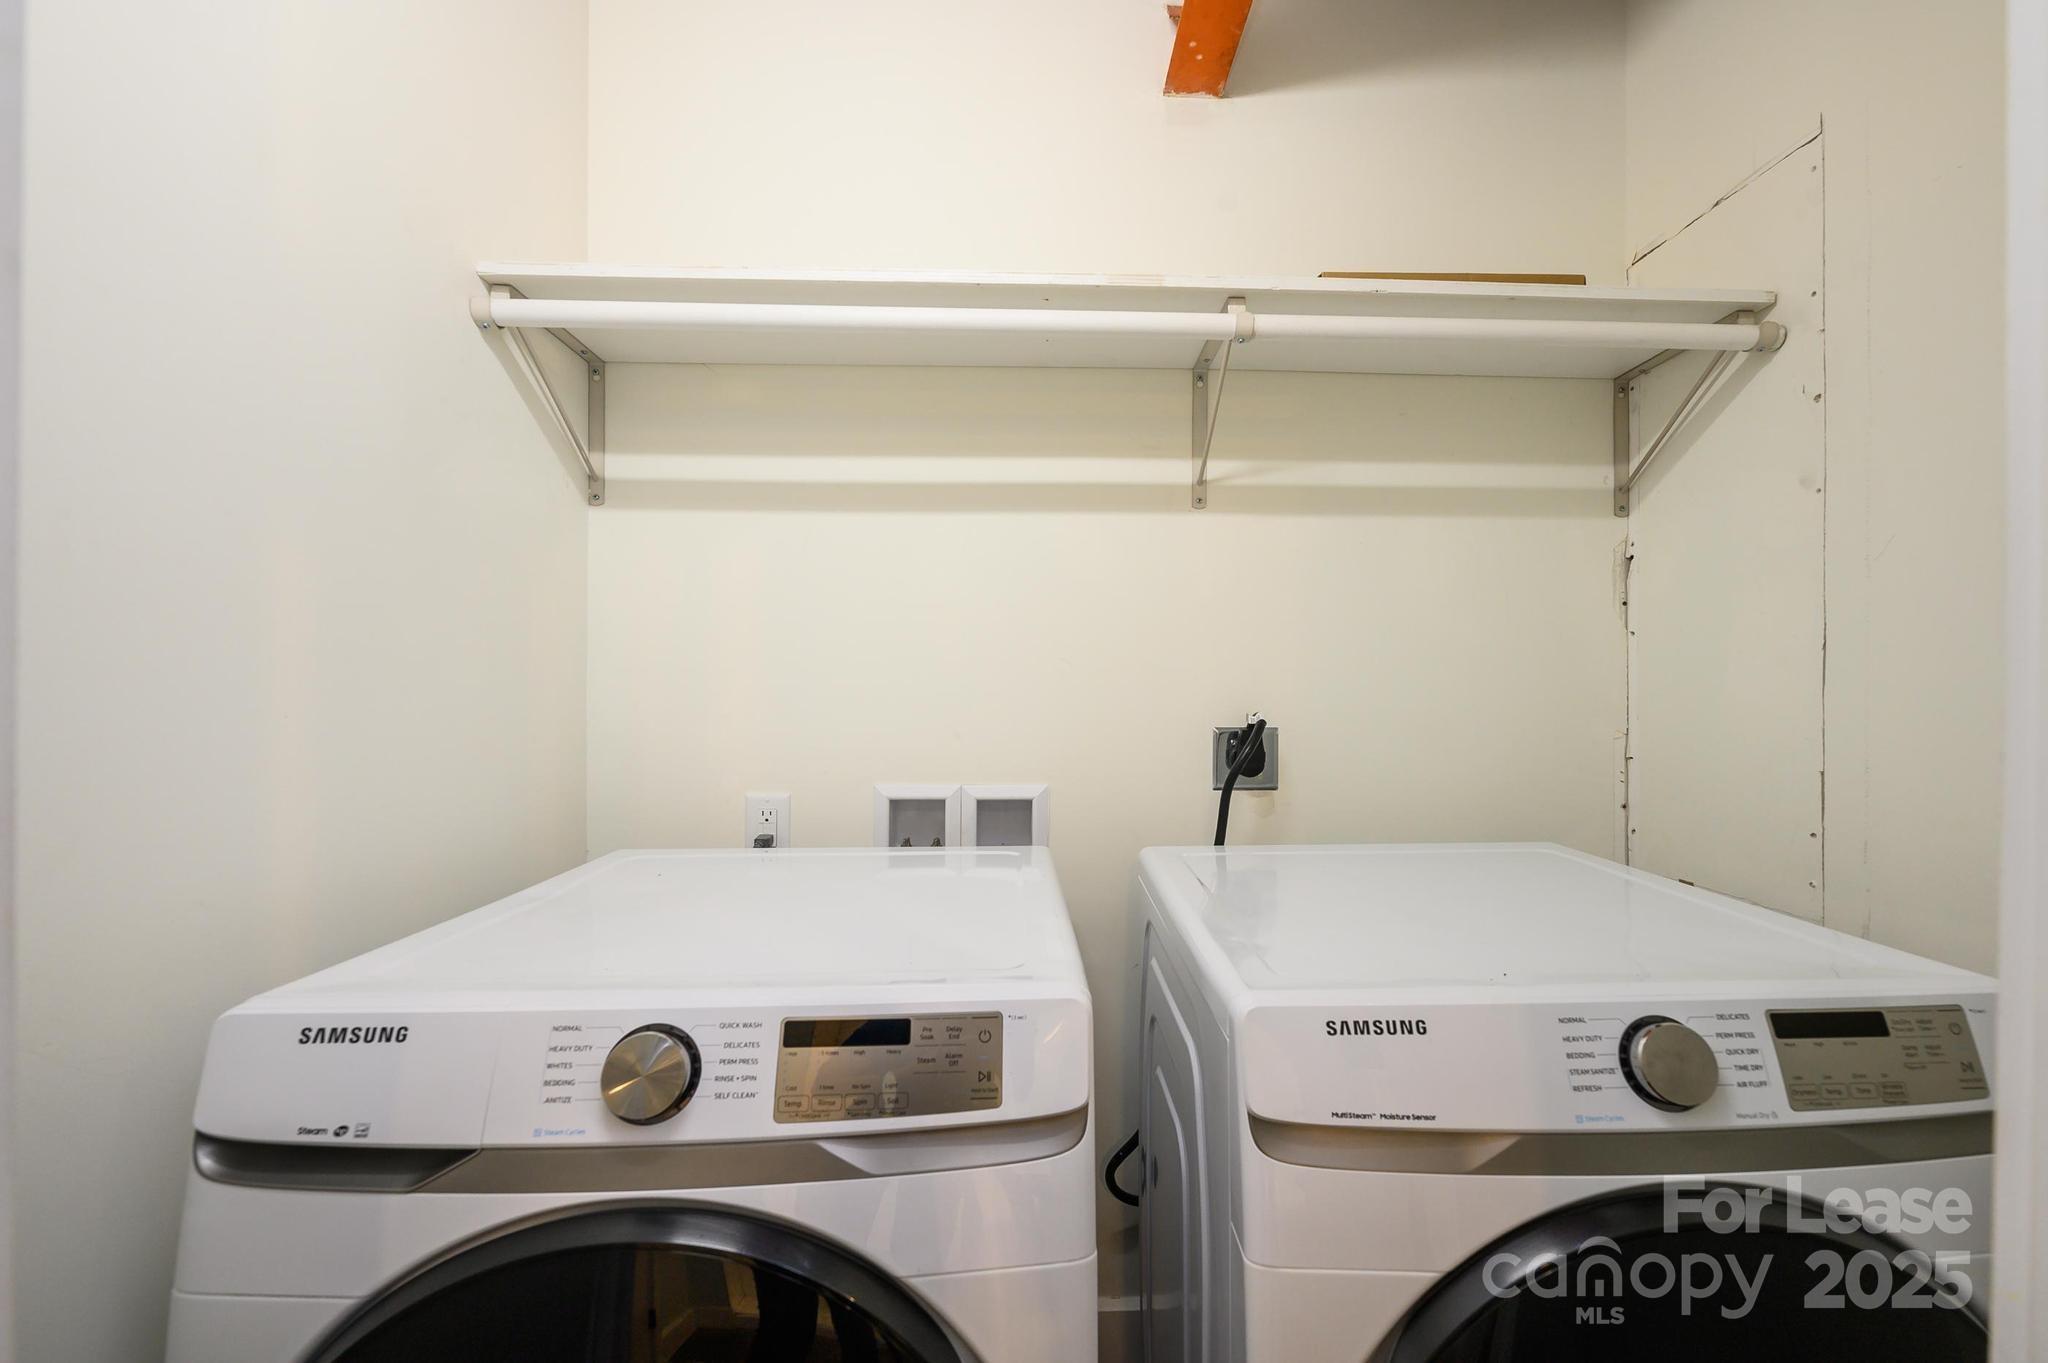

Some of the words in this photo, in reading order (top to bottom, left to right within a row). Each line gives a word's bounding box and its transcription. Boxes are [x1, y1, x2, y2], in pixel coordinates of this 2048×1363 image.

[1326, 1019, 1427, 1036] SAMSUNG
[298, 1026, 409, 1044] SAMSUNG
[543, 1079, 576, 1087] BEDDING
[714, 1092, 730, 1100] SELF
[297, 1127, 329, 1135] Steam
